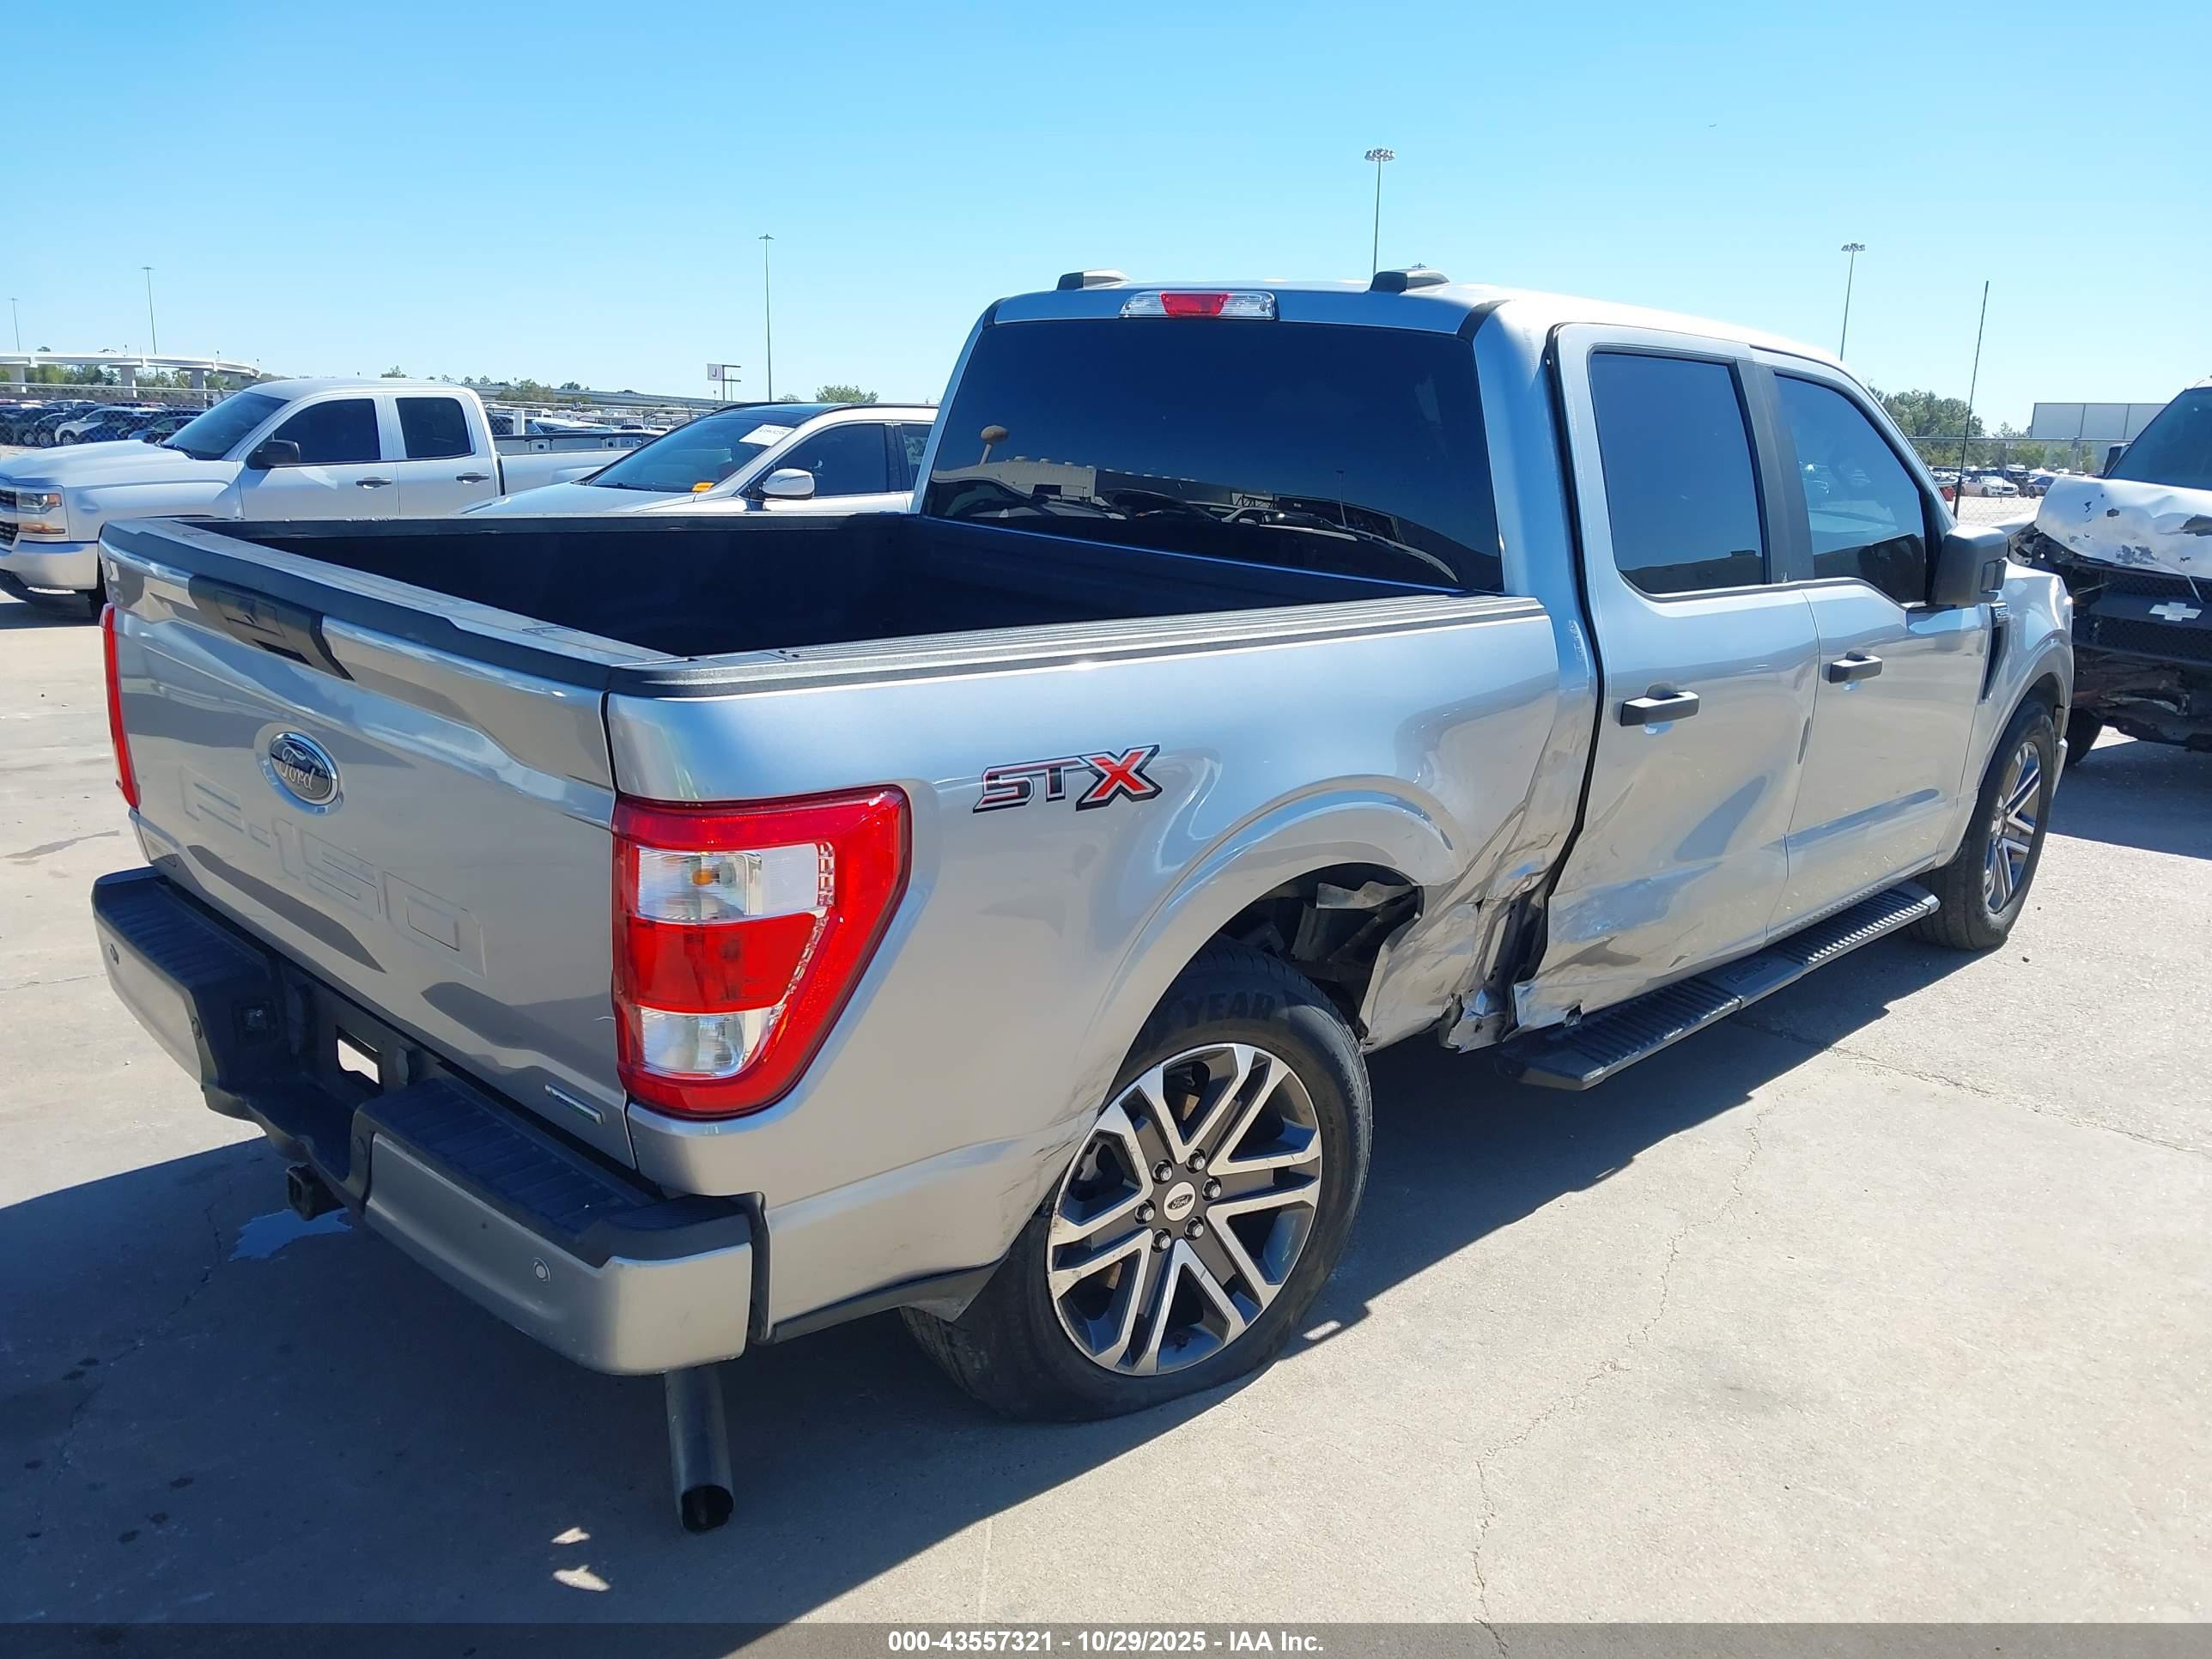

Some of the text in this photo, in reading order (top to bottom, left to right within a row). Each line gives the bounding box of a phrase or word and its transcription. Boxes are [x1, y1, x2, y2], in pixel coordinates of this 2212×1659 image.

[711, 368, 718, 378] J
[972, 743, 1163, 814] STX
[179, 764, 486, 978] F-150
